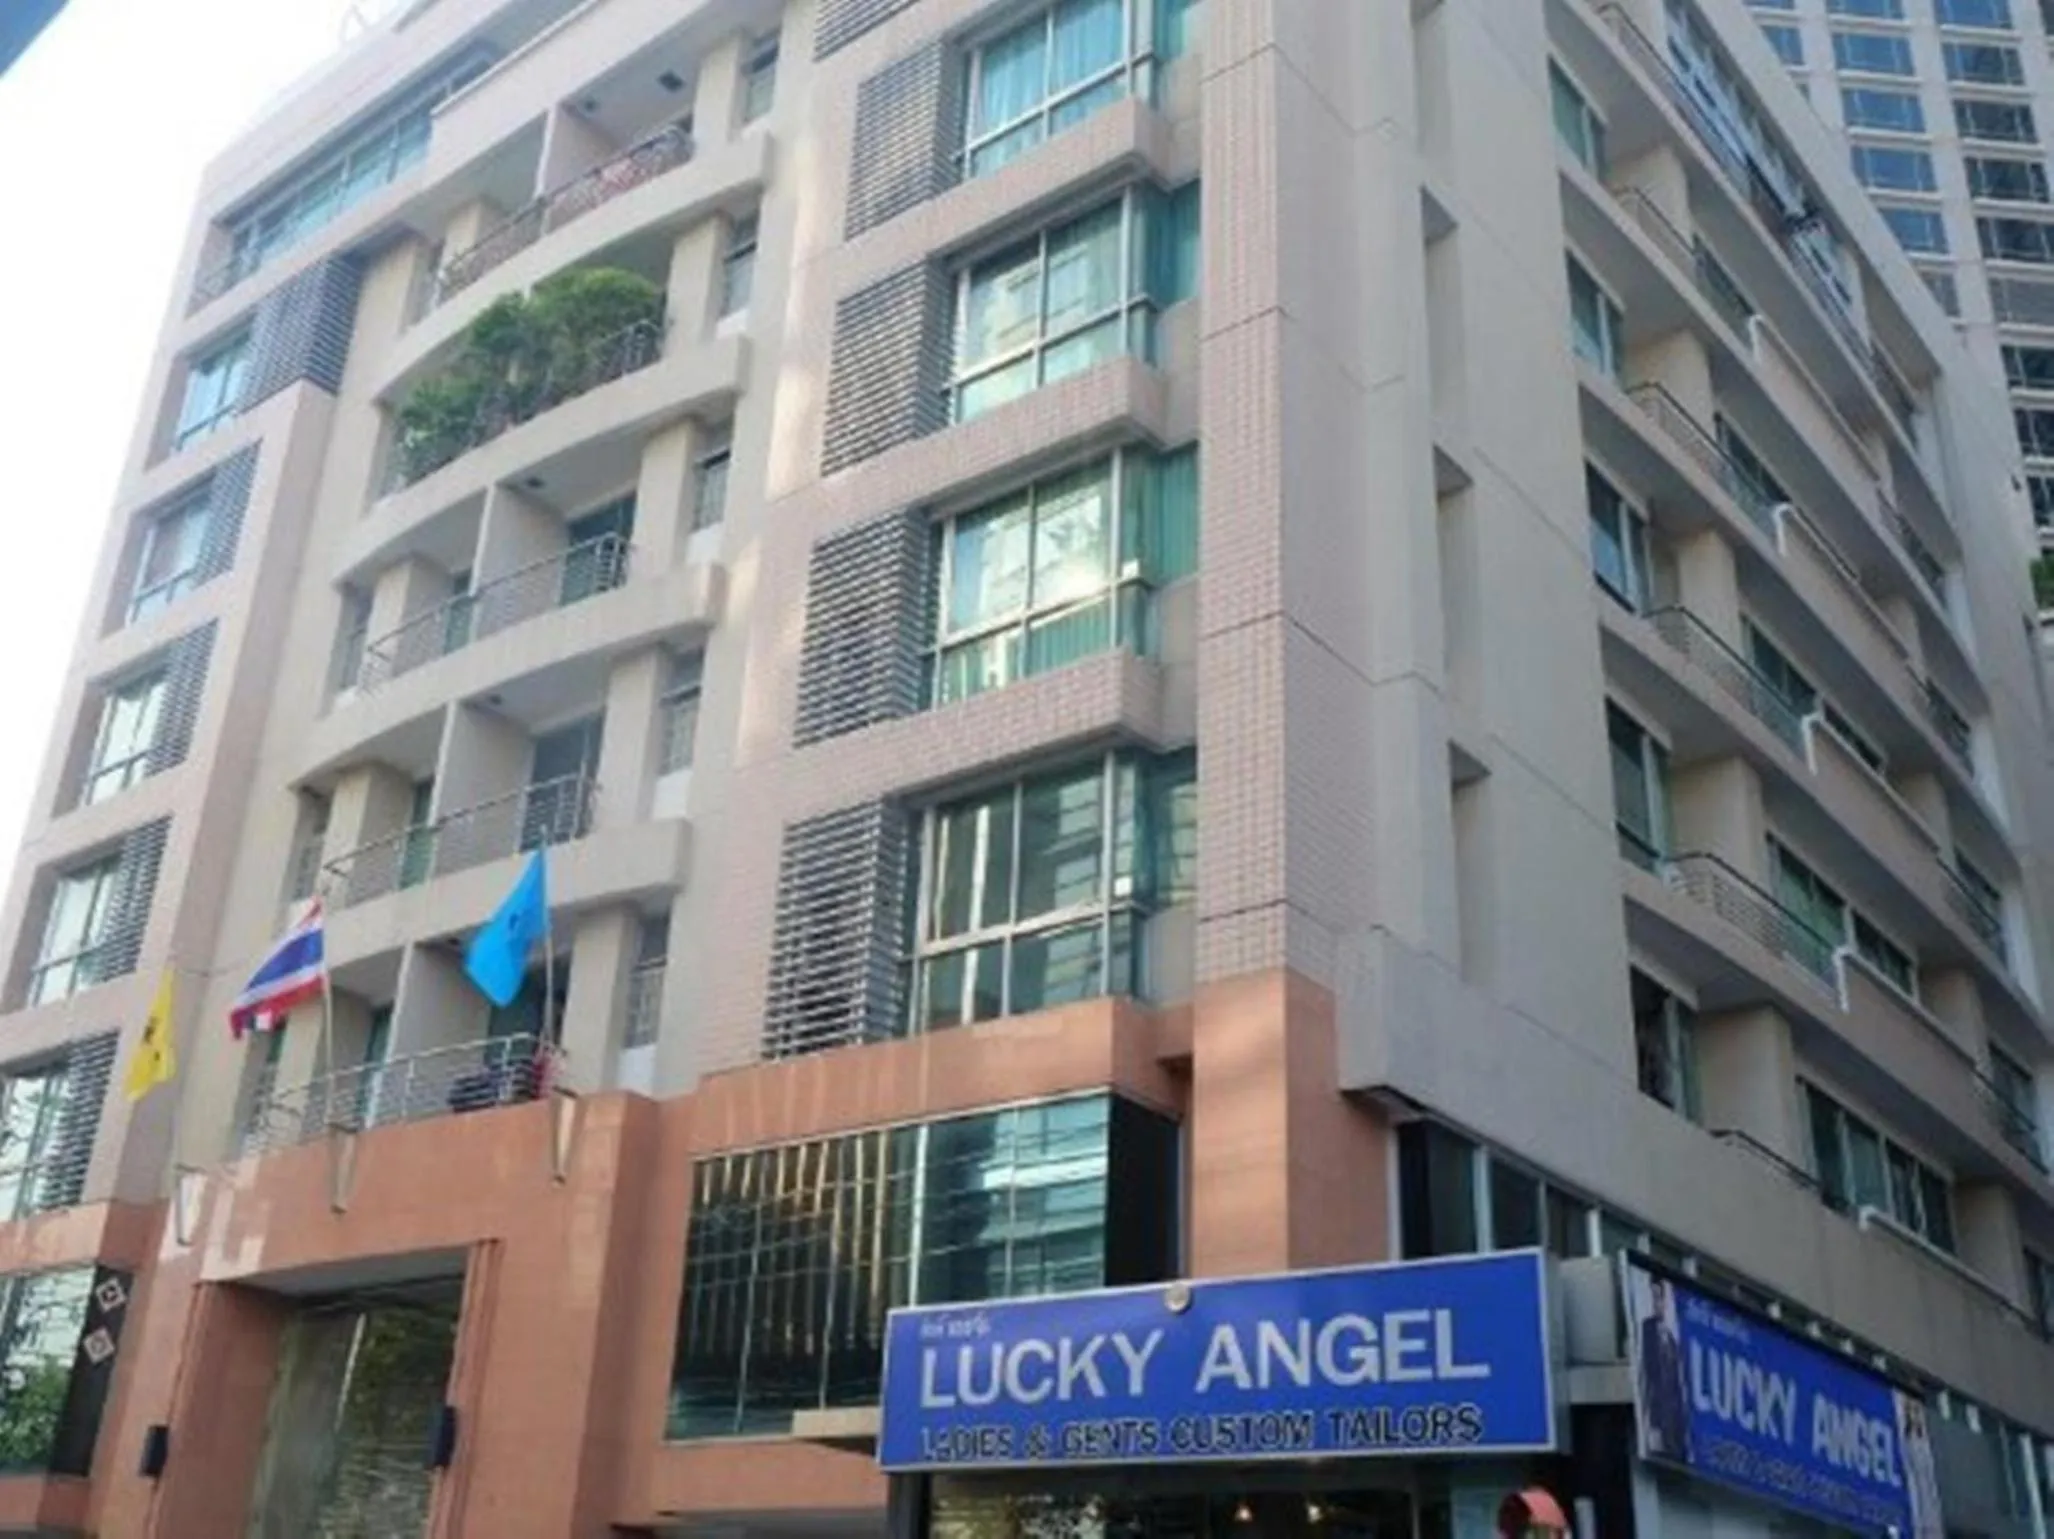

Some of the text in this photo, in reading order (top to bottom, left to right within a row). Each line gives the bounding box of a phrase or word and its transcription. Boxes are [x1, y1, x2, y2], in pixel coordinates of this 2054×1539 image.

[919, 1308, 1490, 1409] LUCKY ANGEL
[920, 1402, 1483, 1462] LADIES & GENTS CUSTOM TAILORS
[1688, 1337, 1797, 1445] LUCKY
[1811, 1392, 1901, 1488] ANGEL
